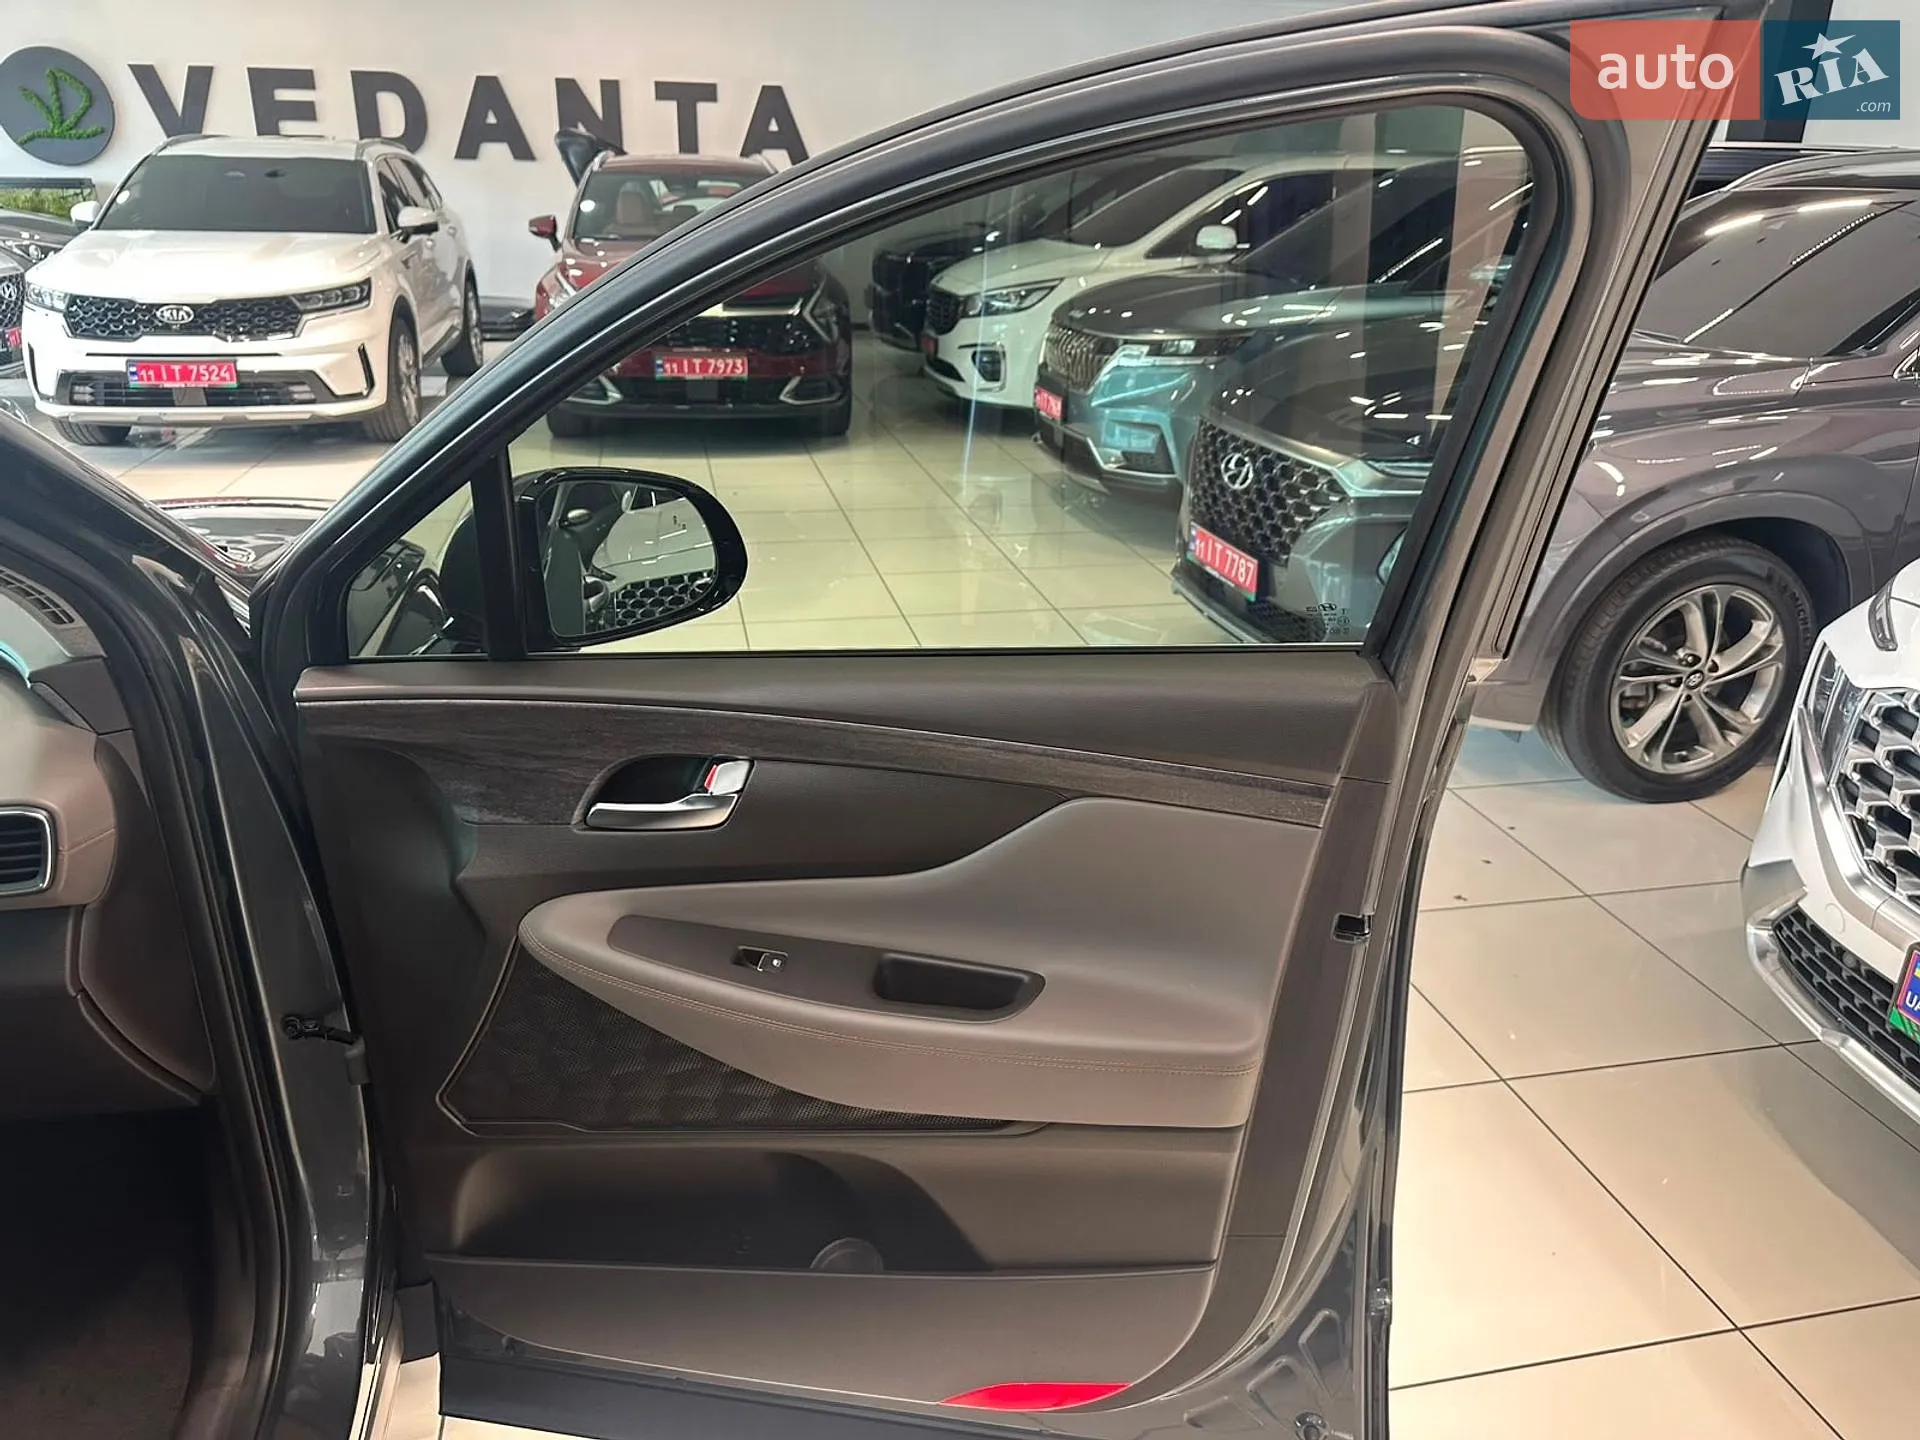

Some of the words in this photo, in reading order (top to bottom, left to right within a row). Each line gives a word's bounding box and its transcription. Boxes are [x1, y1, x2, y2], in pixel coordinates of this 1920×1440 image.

[128, 63, 809, 166] VEDANTA
[161, 308, 190, 322] KIA
[188, 364, 231, 381] 7524
[707, 359, 743, 375] 7973
[1224, 548, 1255, 587] 7787
